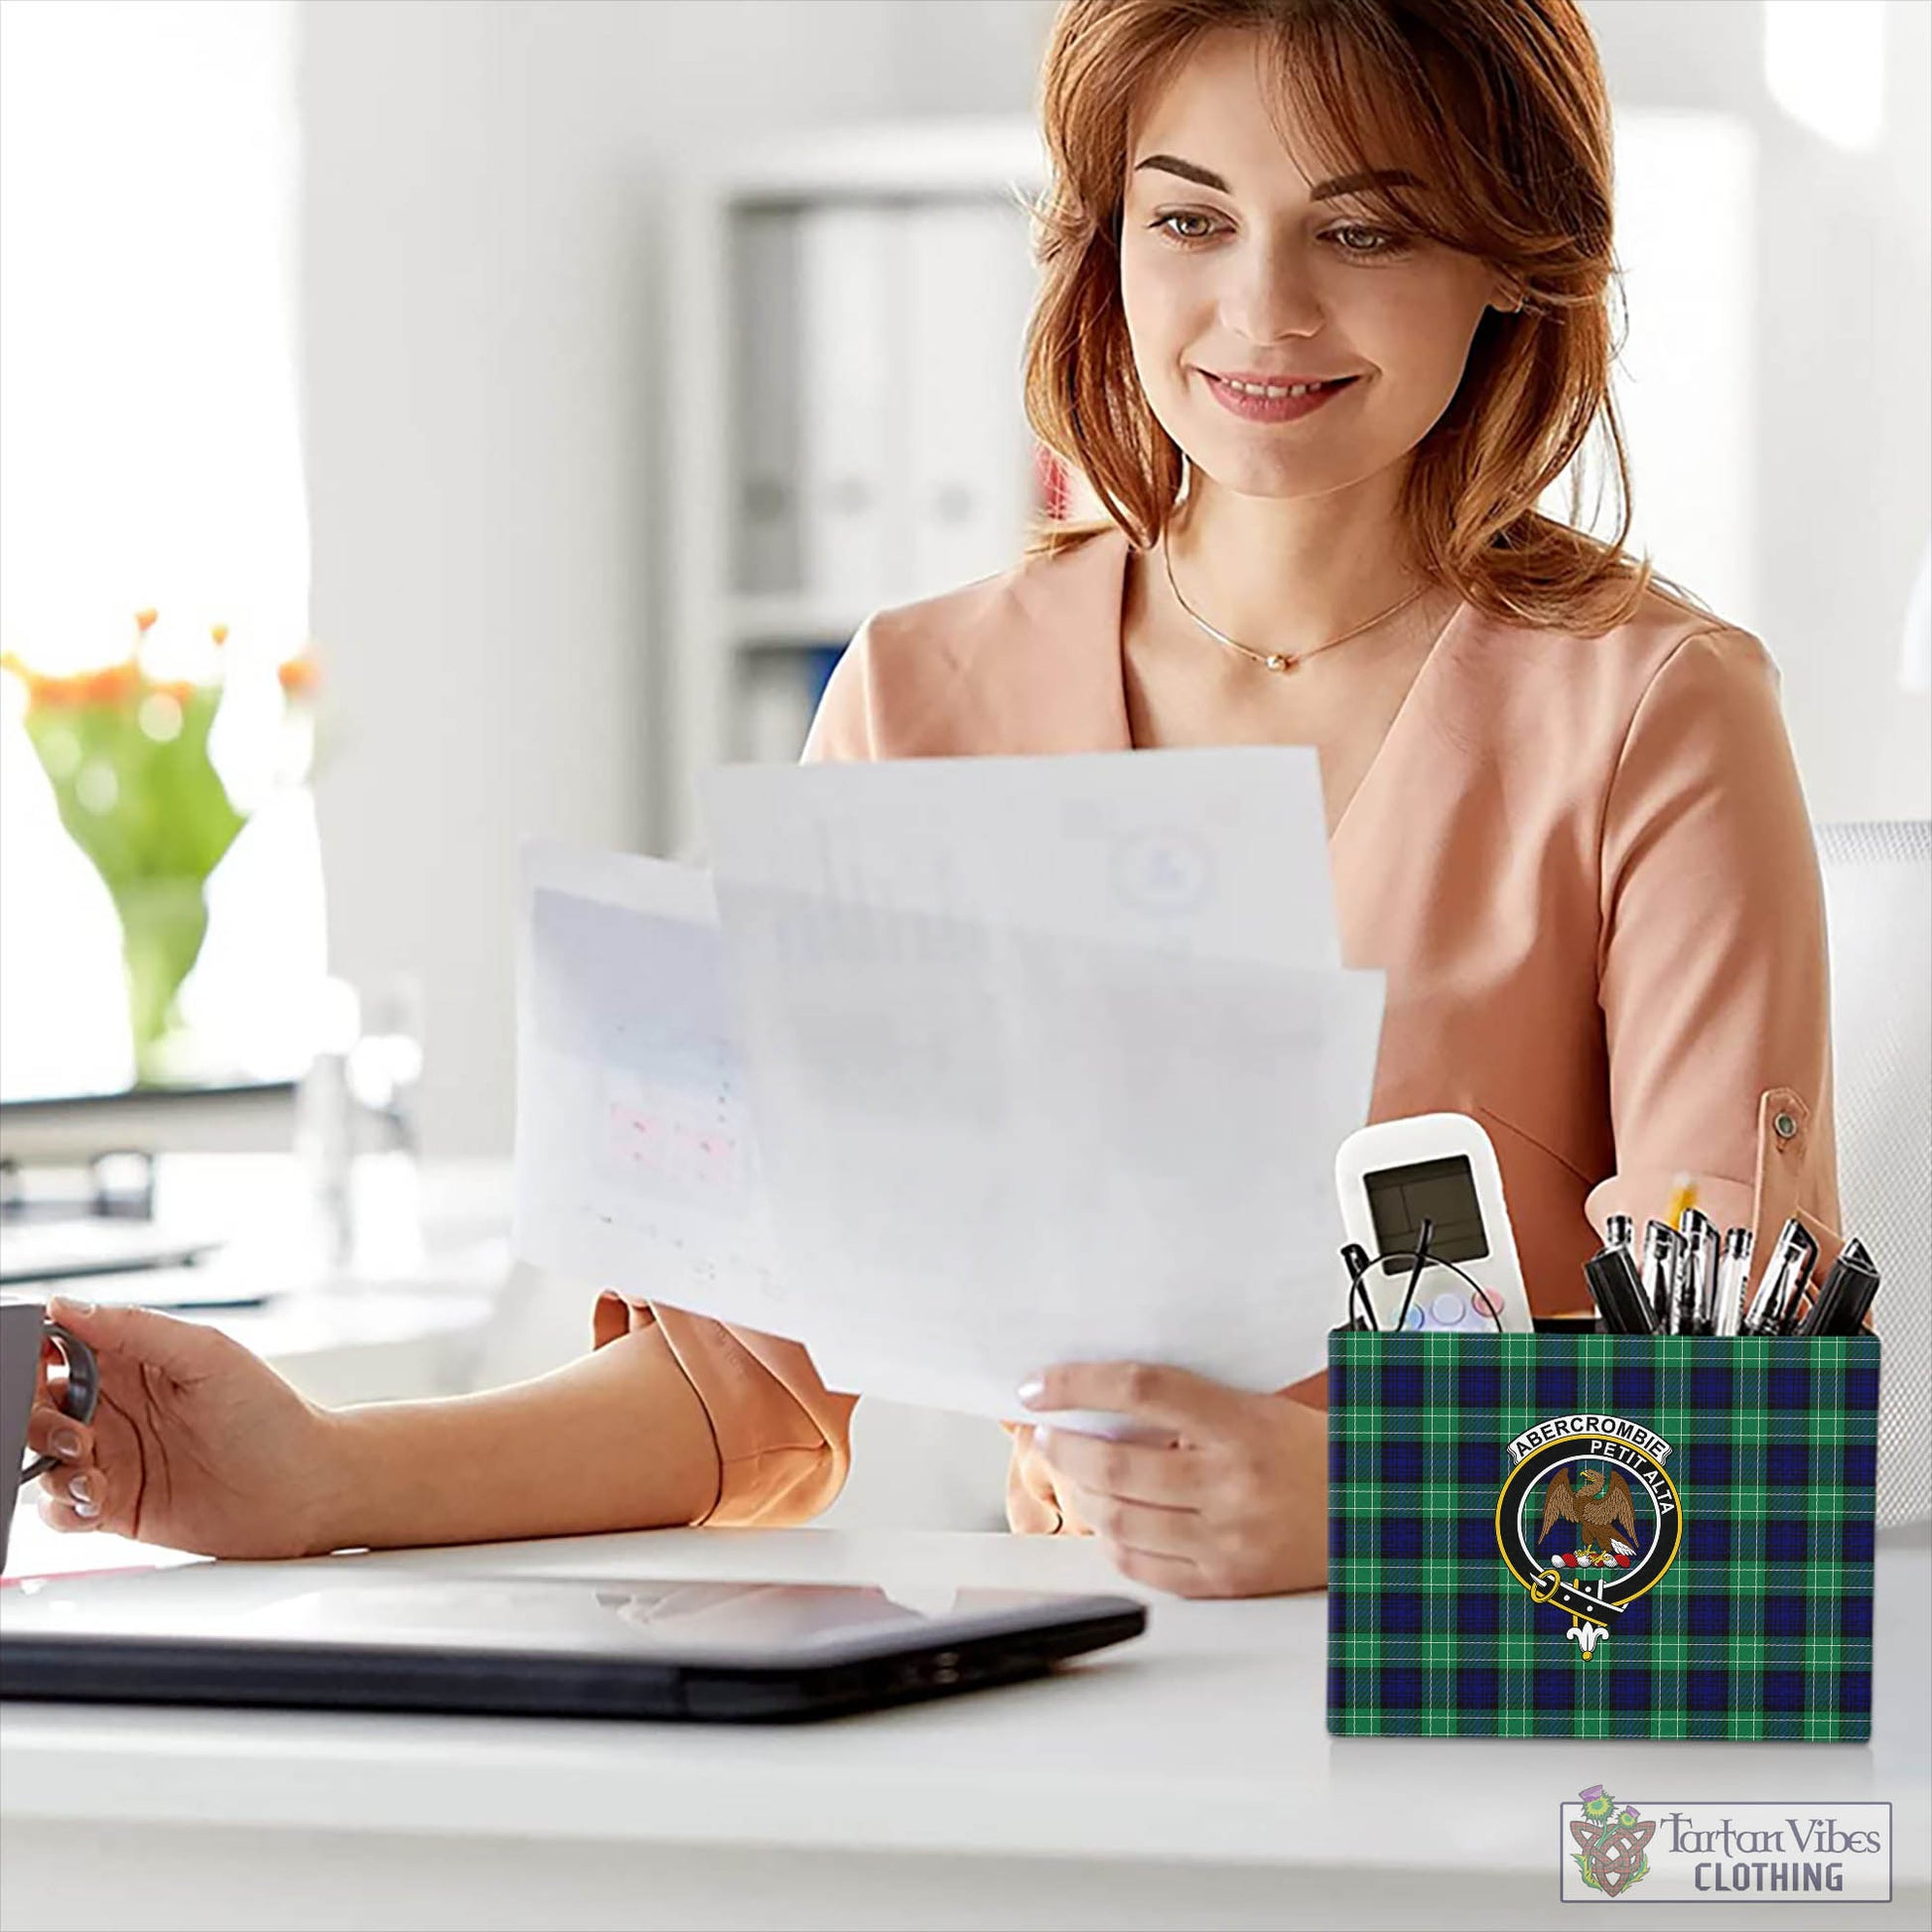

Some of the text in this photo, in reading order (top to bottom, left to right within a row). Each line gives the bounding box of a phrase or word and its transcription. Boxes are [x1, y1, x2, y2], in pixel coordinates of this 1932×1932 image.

[1516, 1417, 1666, 1457] ABERCROMBIE
[1590, 1441, 1675, 1515] PETIT ALTA
